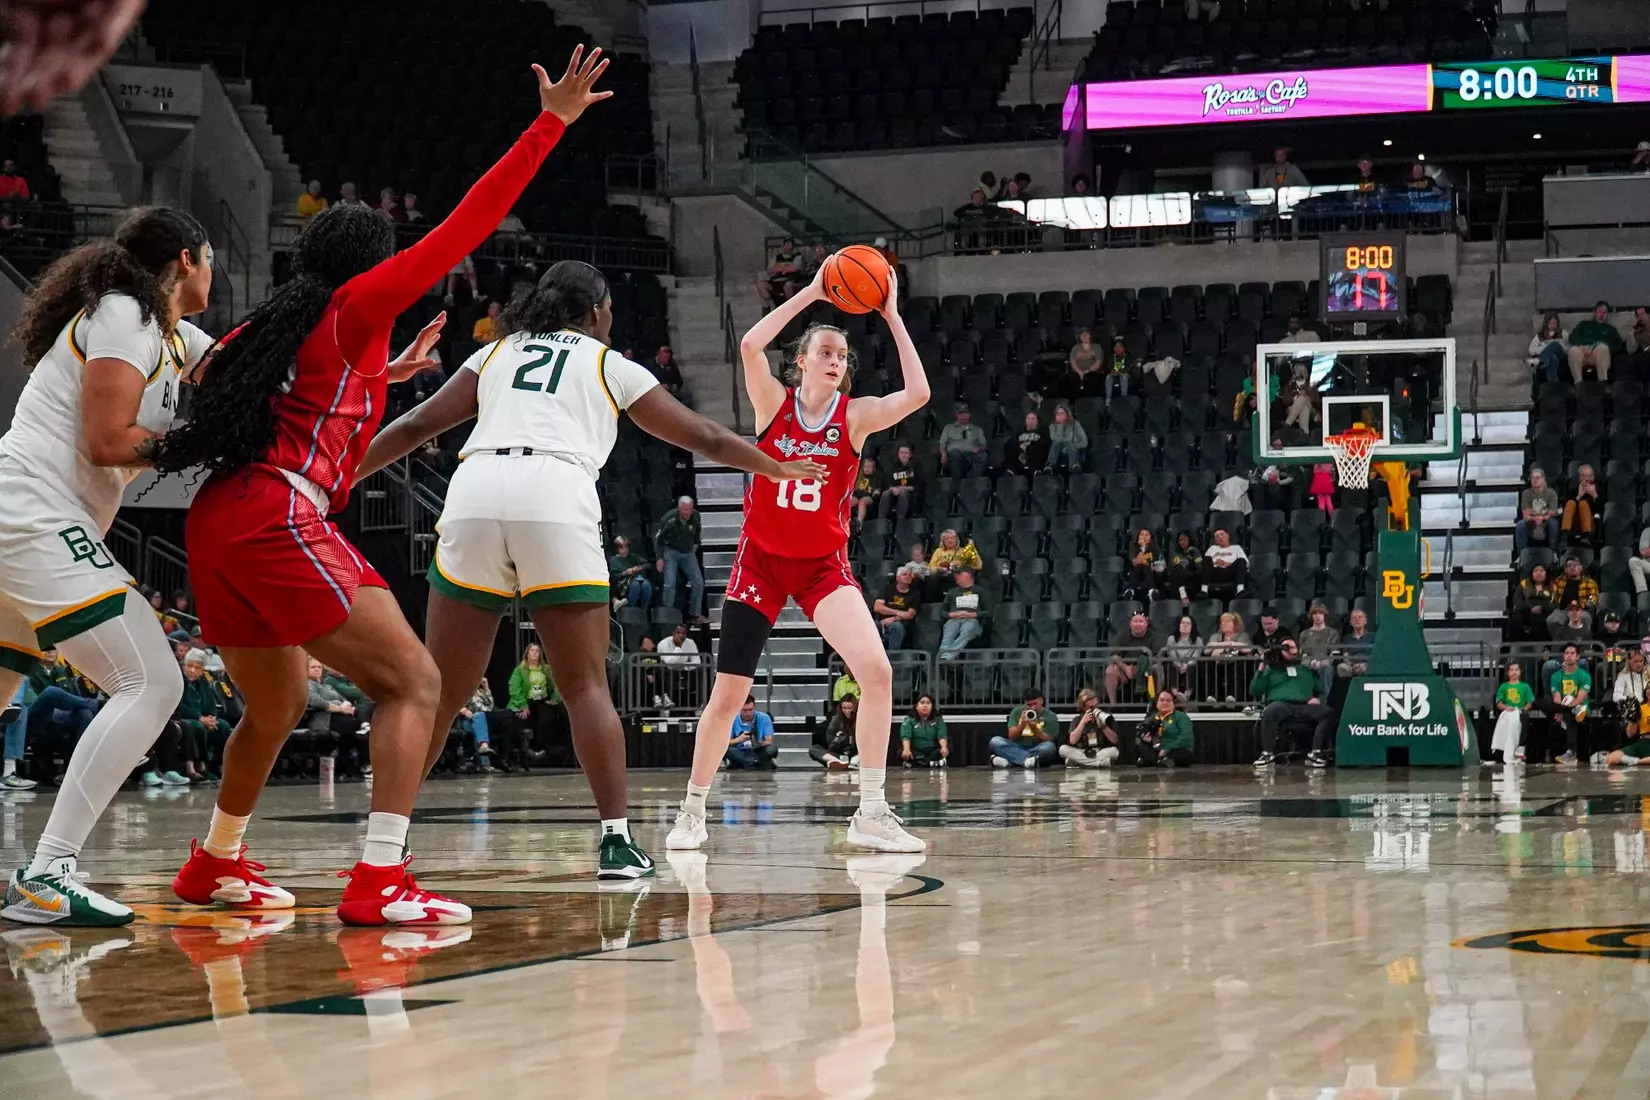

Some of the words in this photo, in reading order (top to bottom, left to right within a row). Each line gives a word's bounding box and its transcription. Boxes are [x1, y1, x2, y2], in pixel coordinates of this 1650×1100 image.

[1459, 66, 1538, 101] 8:00
[1565, 66, 1599, 82] 4TH
[1565, 84, 1600, 99] QTR
[1202, 82, 1259, 118] Rosa's
[1265, 76, 1309, 108] Café
[1225, 106, 1253, 116] TORTILLA
[1260, 104, 1287, 115] FACTORY
[1346, 245, 1393, 270] 8:00
[1355, 271, 1387, 311] 17
[511, 344, 570, 395] 21
[776, 477, 822, 512] 18
[58, 525, 114, 569] BU
[1382, 570, 1414, 609] BU
[1348, 724, 1374, 736] Your
[1377, 724, 1406, 736] Bank
[1408, 724, 1425, 736] for
[1427, 724, 1448, 736] Life
